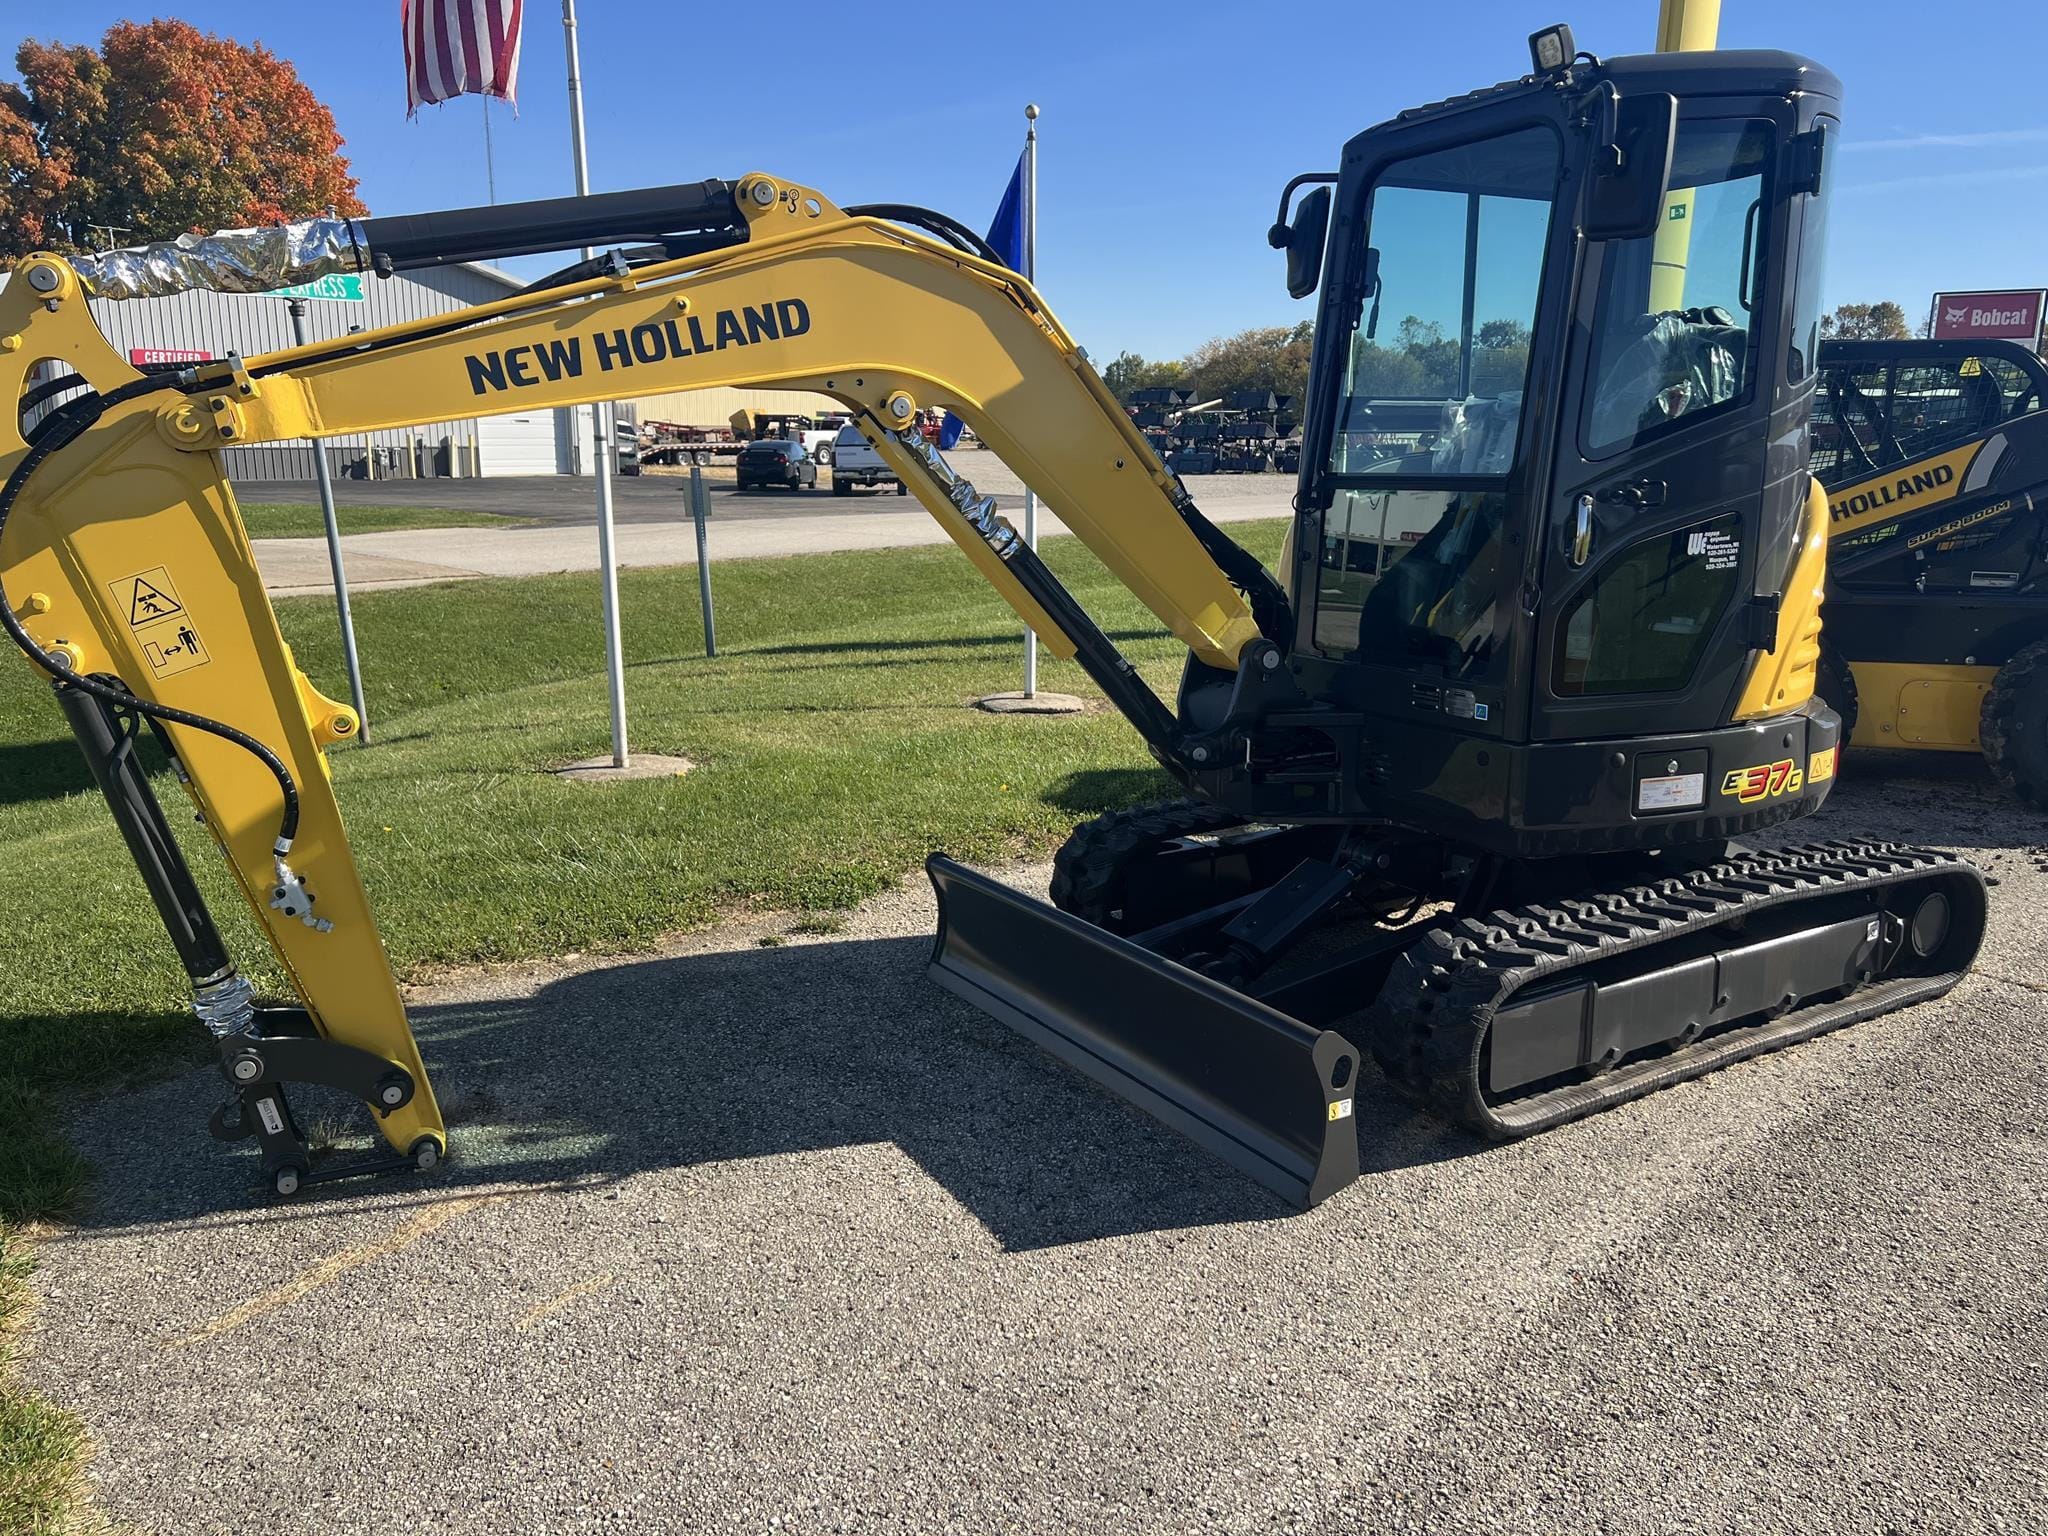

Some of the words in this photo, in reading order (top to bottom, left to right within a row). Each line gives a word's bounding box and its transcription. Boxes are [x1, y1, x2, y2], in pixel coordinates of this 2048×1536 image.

[1971, 308, 2028, 326] Bobcat
[144, 351, 201, 363] CERTIFIED
[464, 337, 583, 395] NEW
[593, 298, 811, 371] HOLLAND
[1830, 464, 1953, 522] HOLLAND
[1908, 519, 1962, 548] SUPER
[1962, 500, 2011, 527] BOOM
